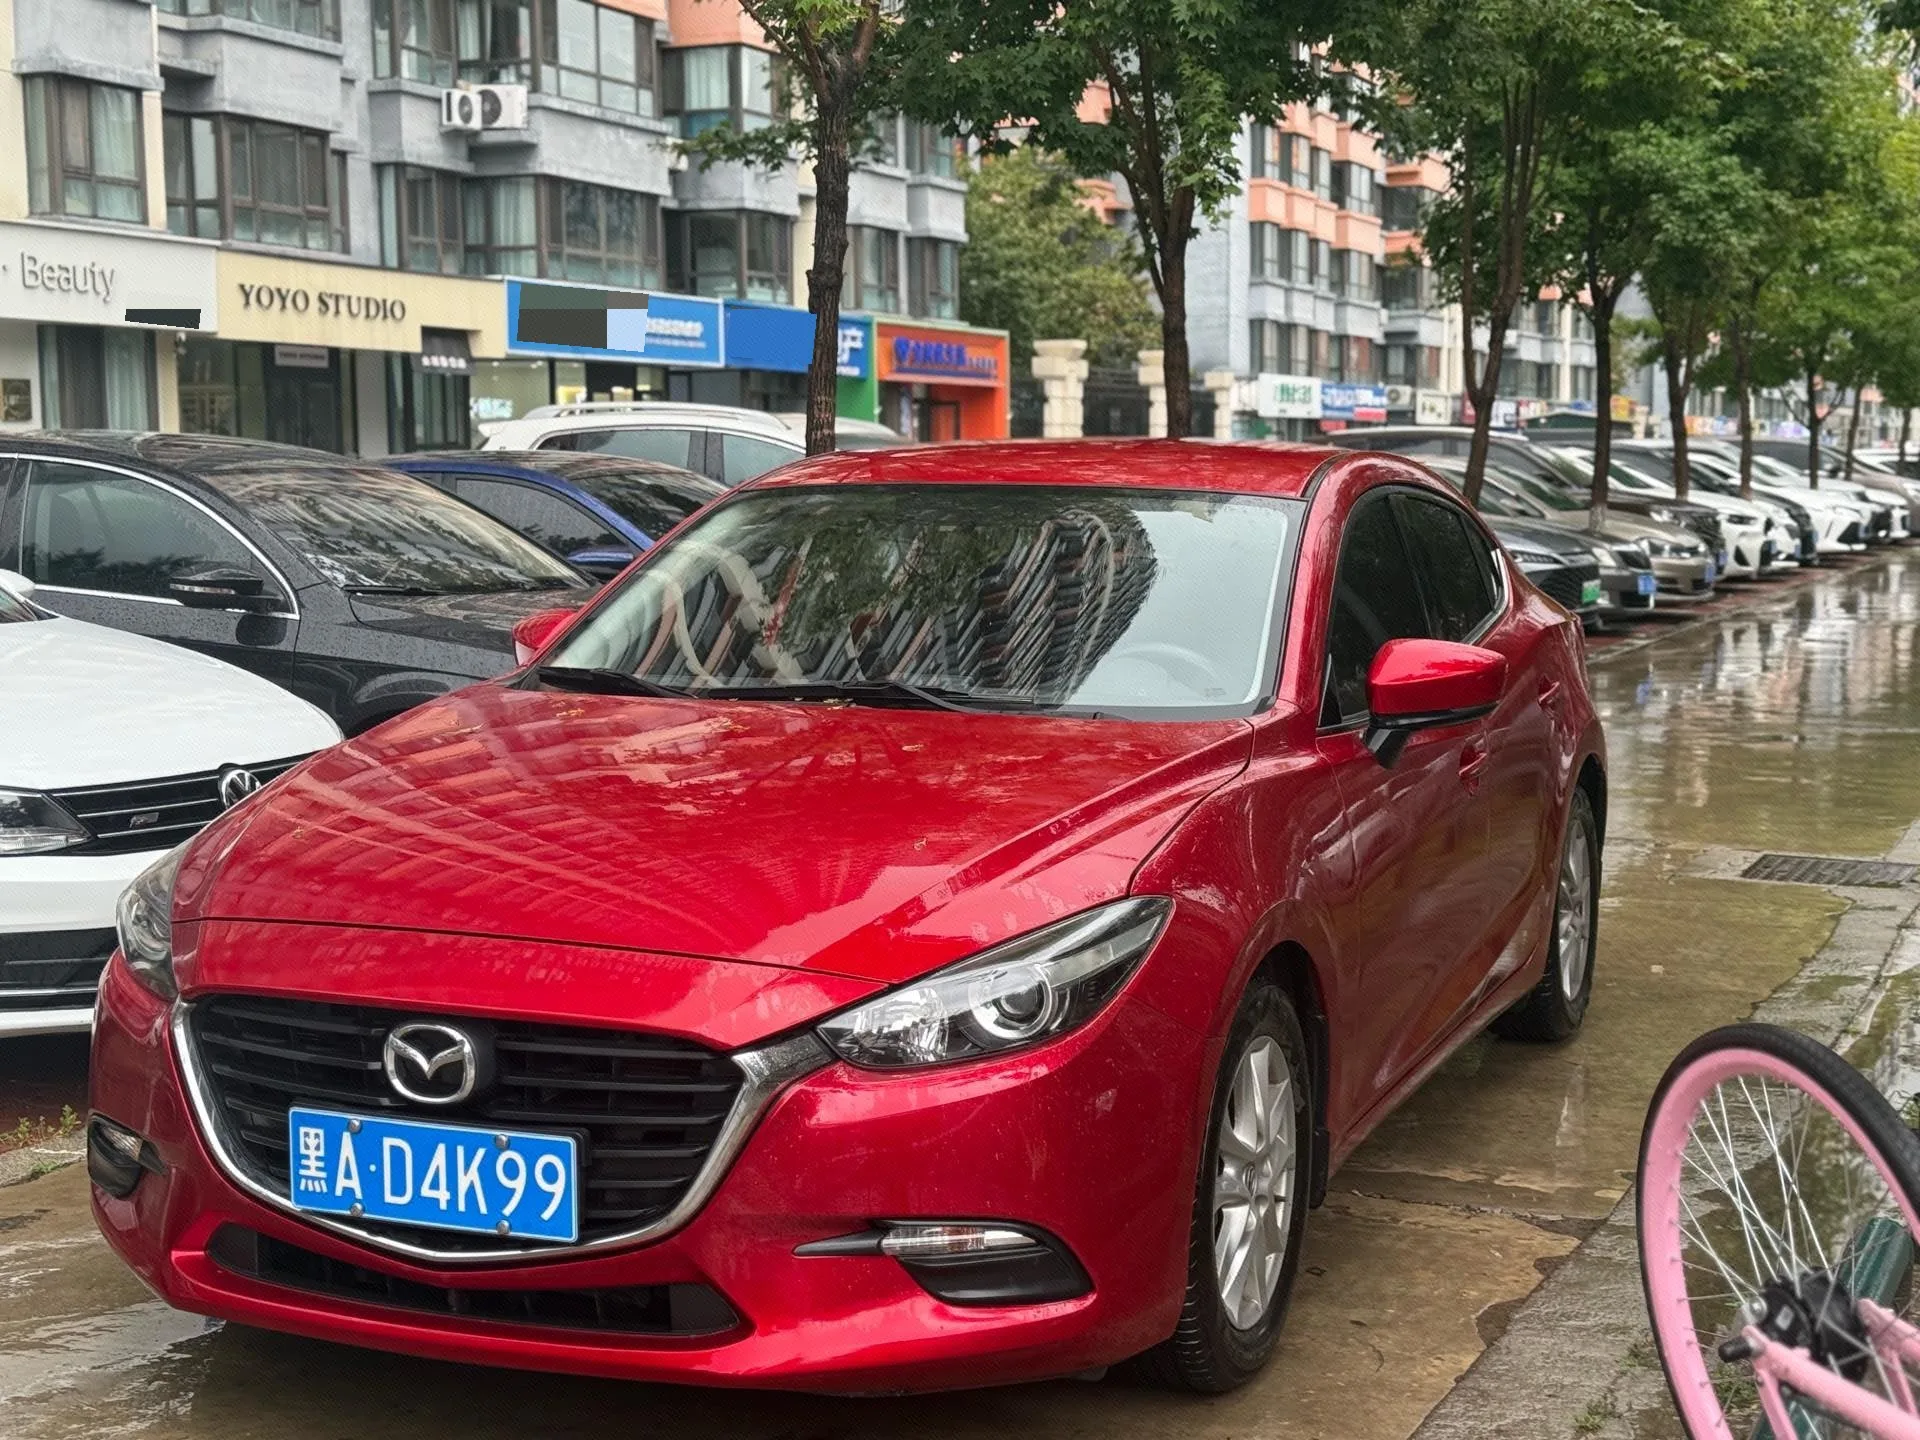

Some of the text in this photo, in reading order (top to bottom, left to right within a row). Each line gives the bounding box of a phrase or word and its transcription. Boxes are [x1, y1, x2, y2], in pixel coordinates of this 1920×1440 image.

[20, 251, 115, 304] Beauty
[238, 283, 407, 321] YOYO STUDIO
